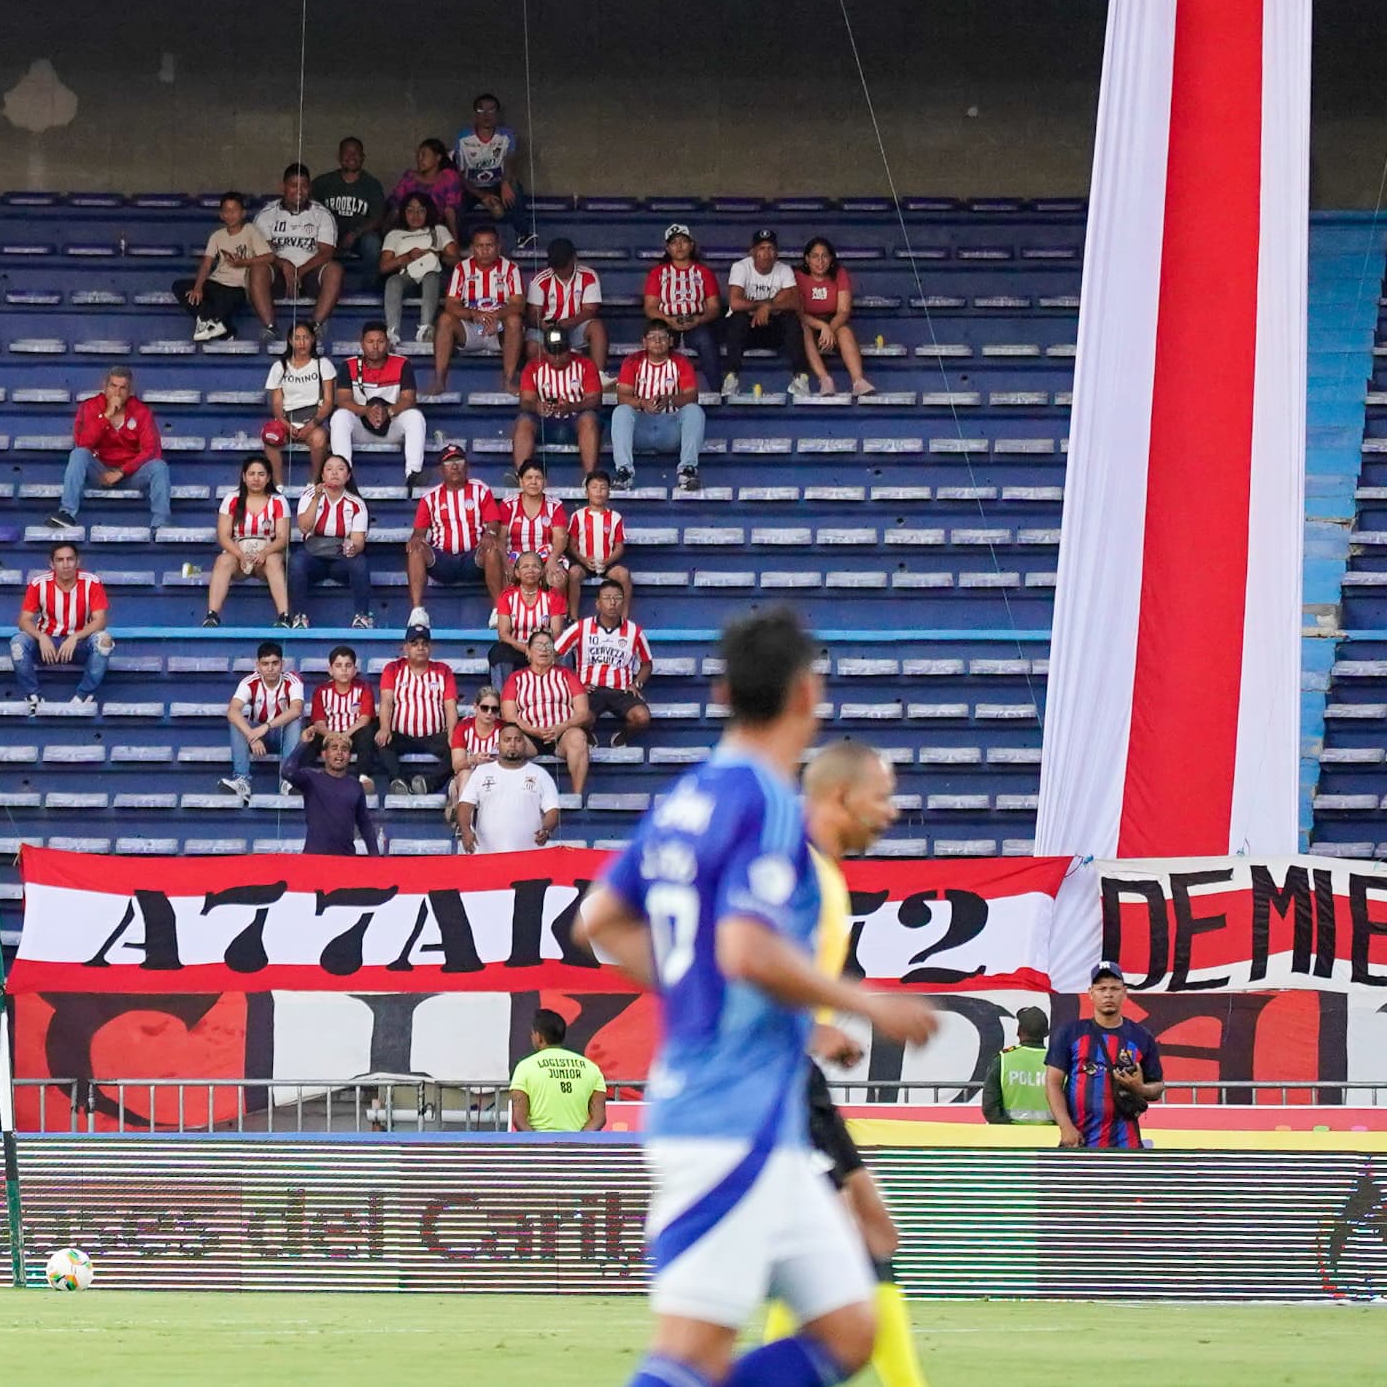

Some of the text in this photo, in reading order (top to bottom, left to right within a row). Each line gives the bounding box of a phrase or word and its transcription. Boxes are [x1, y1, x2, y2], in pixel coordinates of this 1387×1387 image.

[271, 234, 317, 250] CERVEZA
[588, 646, 628, 662] CERVEZA
[1100, 868, 1234, 993] DE
[547, 1068, 583, 1081] JUNIOR
